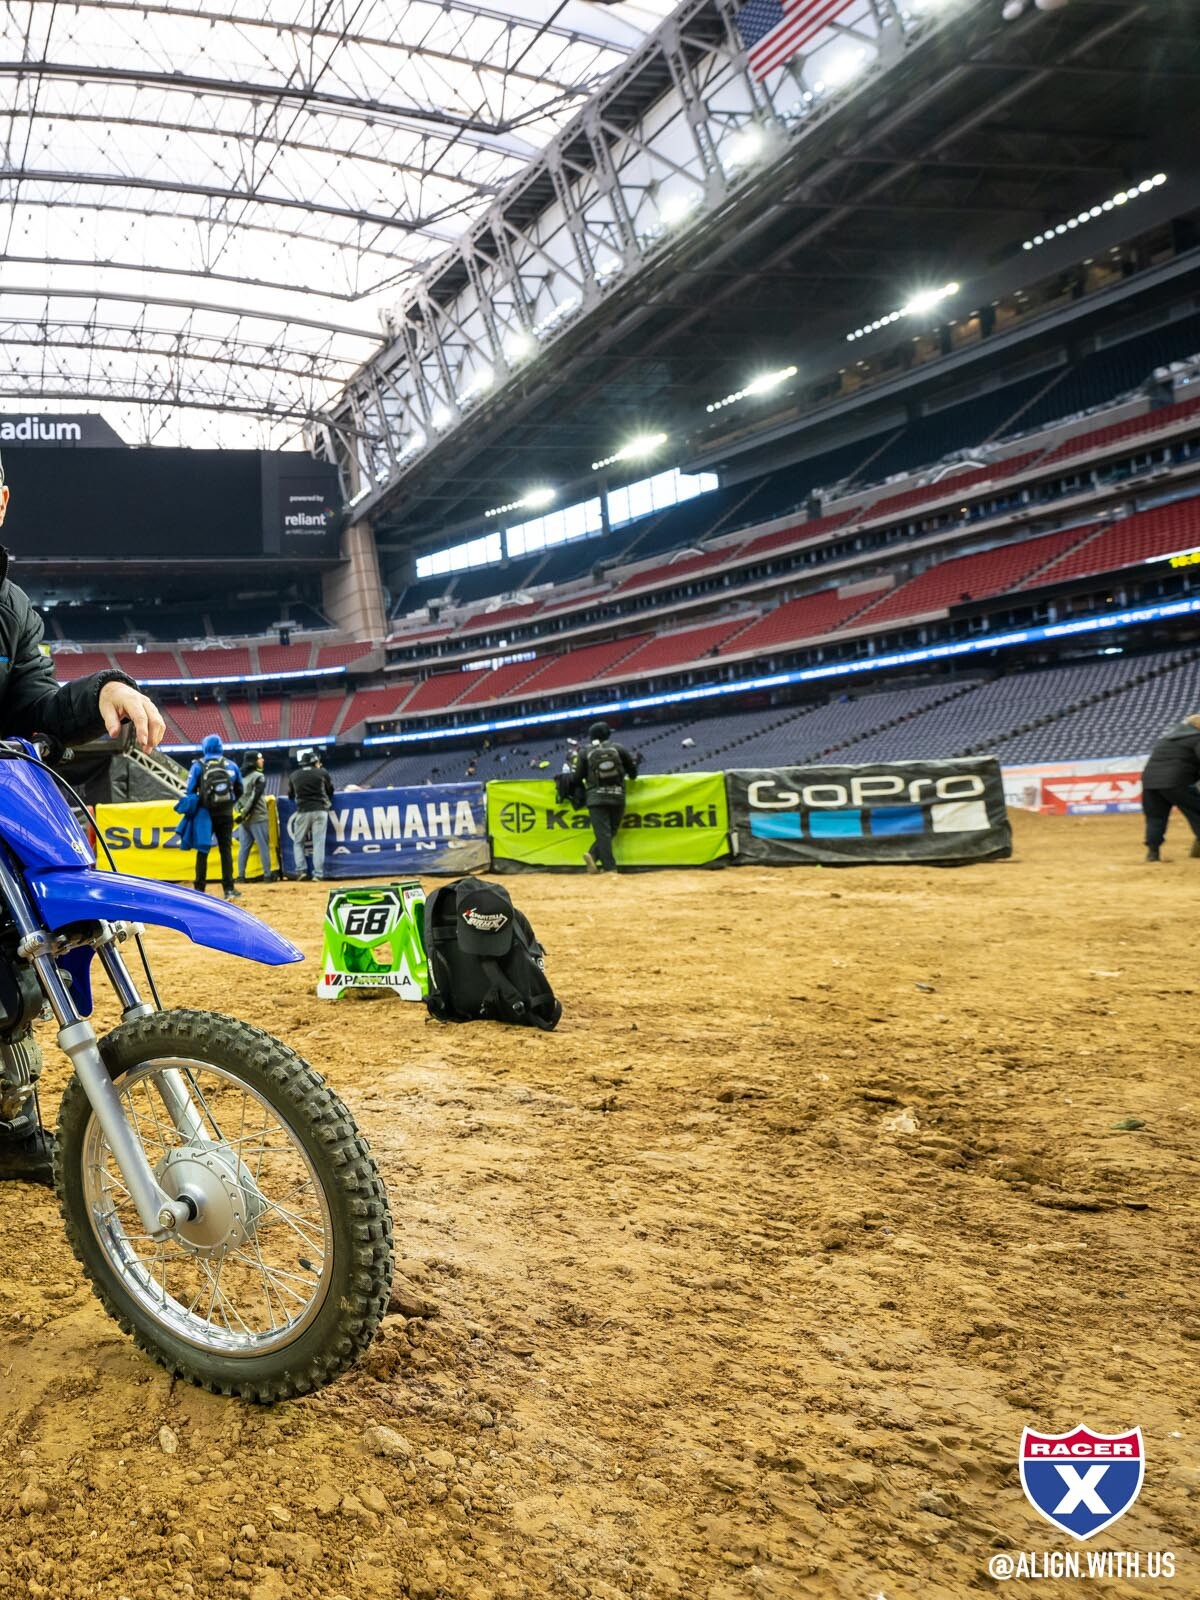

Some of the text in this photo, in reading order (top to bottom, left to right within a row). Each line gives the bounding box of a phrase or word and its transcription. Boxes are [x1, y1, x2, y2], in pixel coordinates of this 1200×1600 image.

[285, 512, 327, 526] reliant
[747, 774, 985, 809] GoPro
[328, 800, 478, 842] YAMAHA
[546, 804, 718, 830] Kaasaki
[105, 826, 240, 850] SUZ
[304, 840, 477, 855] ACING
[344, 907, 391, 936] 68
[344, 973, 412, 986] PARTZILLA
